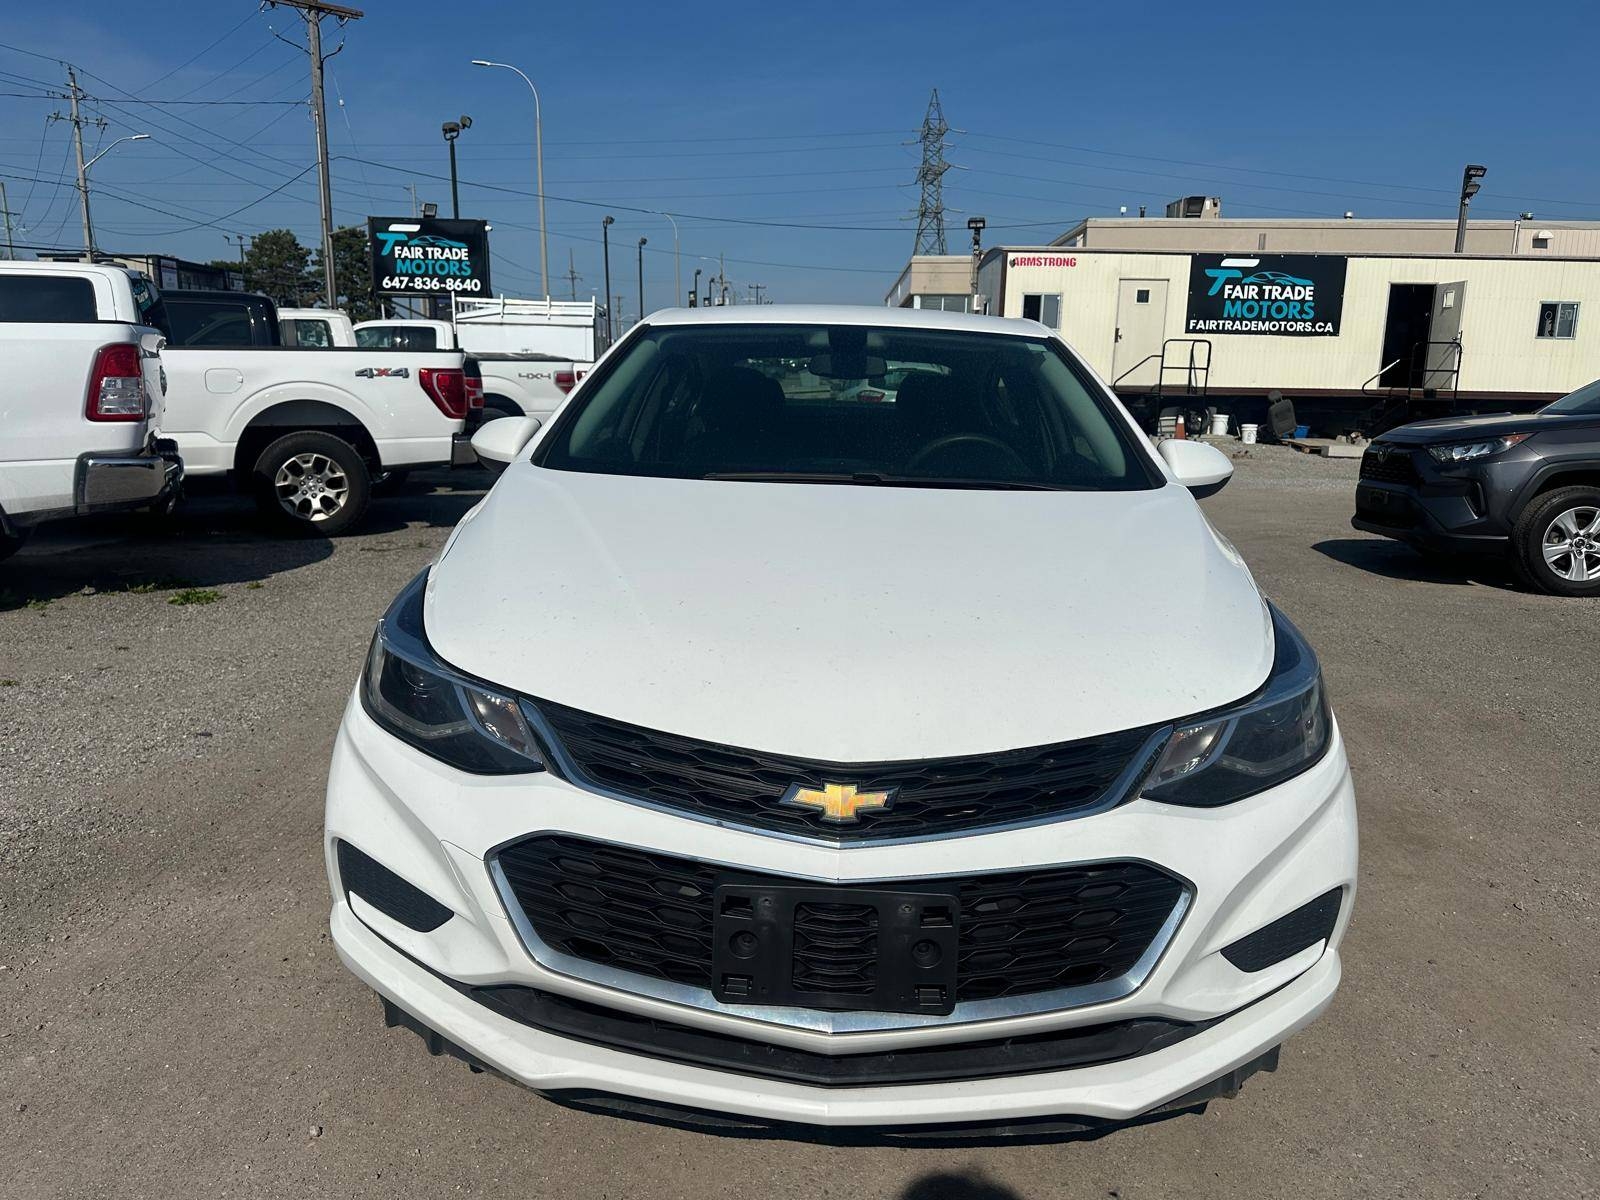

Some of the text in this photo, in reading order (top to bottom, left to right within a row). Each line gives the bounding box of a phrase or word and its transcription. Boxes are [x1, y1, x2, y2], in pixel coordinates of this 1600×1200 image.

[394, 246, 469, 260] FAIR TRADE
[396, 259, 472, 276] MOTORS
[1013, 256, 1077, 267] ARMSTRONG
[382, 276, 481, 291] 647-836-8640
[1223, 285, 1315, 301] FAIR TRADE
[1223, 300, 1315, 320] MOTORS
[1189, 319, 1334, 333] FAIRTRADEMOTORS.CA
